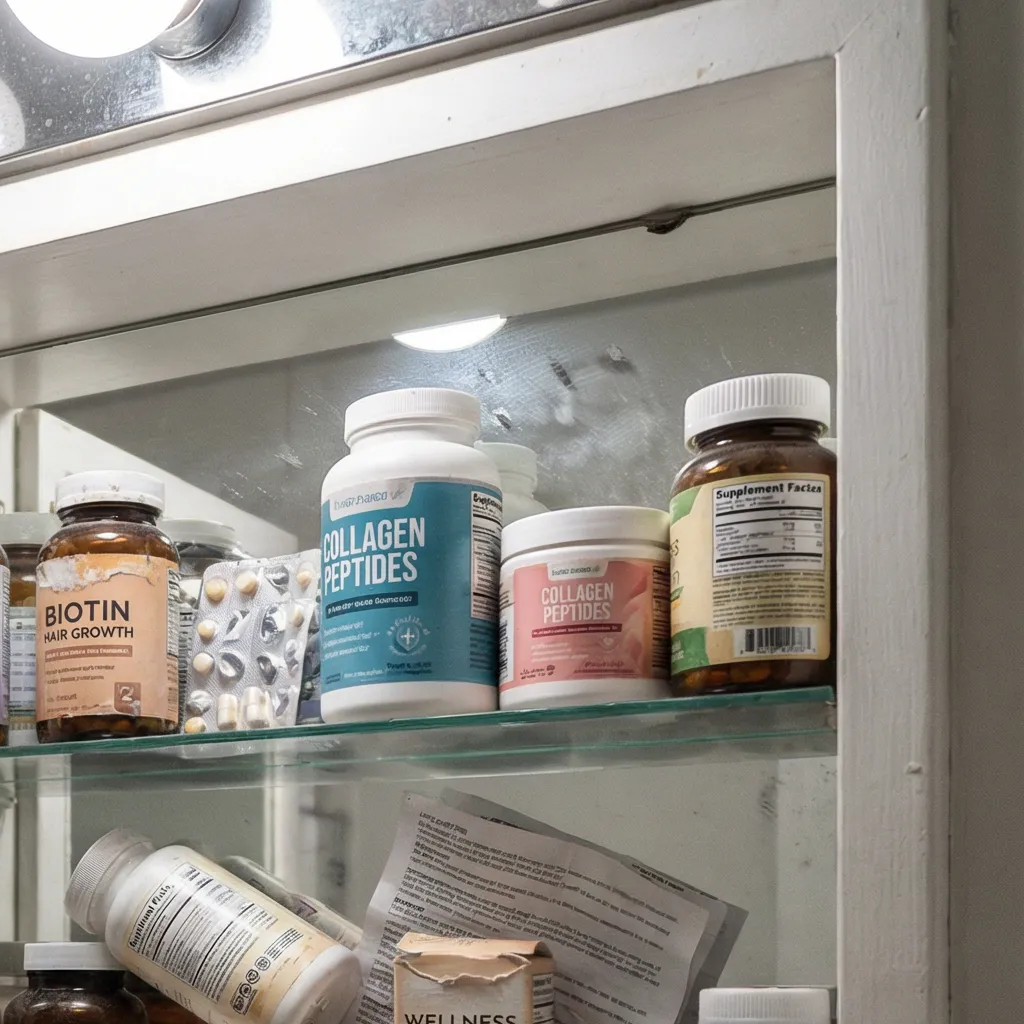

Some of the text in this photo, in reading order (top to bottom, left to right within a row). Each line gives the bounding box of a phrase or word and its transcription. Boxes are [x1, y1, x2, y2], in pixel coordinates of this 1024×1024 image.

[323, 517, 425, 563] COLLAGEN
[324, 551, 418, 596] PEPTIDES
[541, 582, 614, 605] COLLAGEN
[45, 600, 129, 627] BIOTIN
[543, 602, 611, 624] PEPTIDES
[44, 626, 134, 643] HAIR GROWTH
